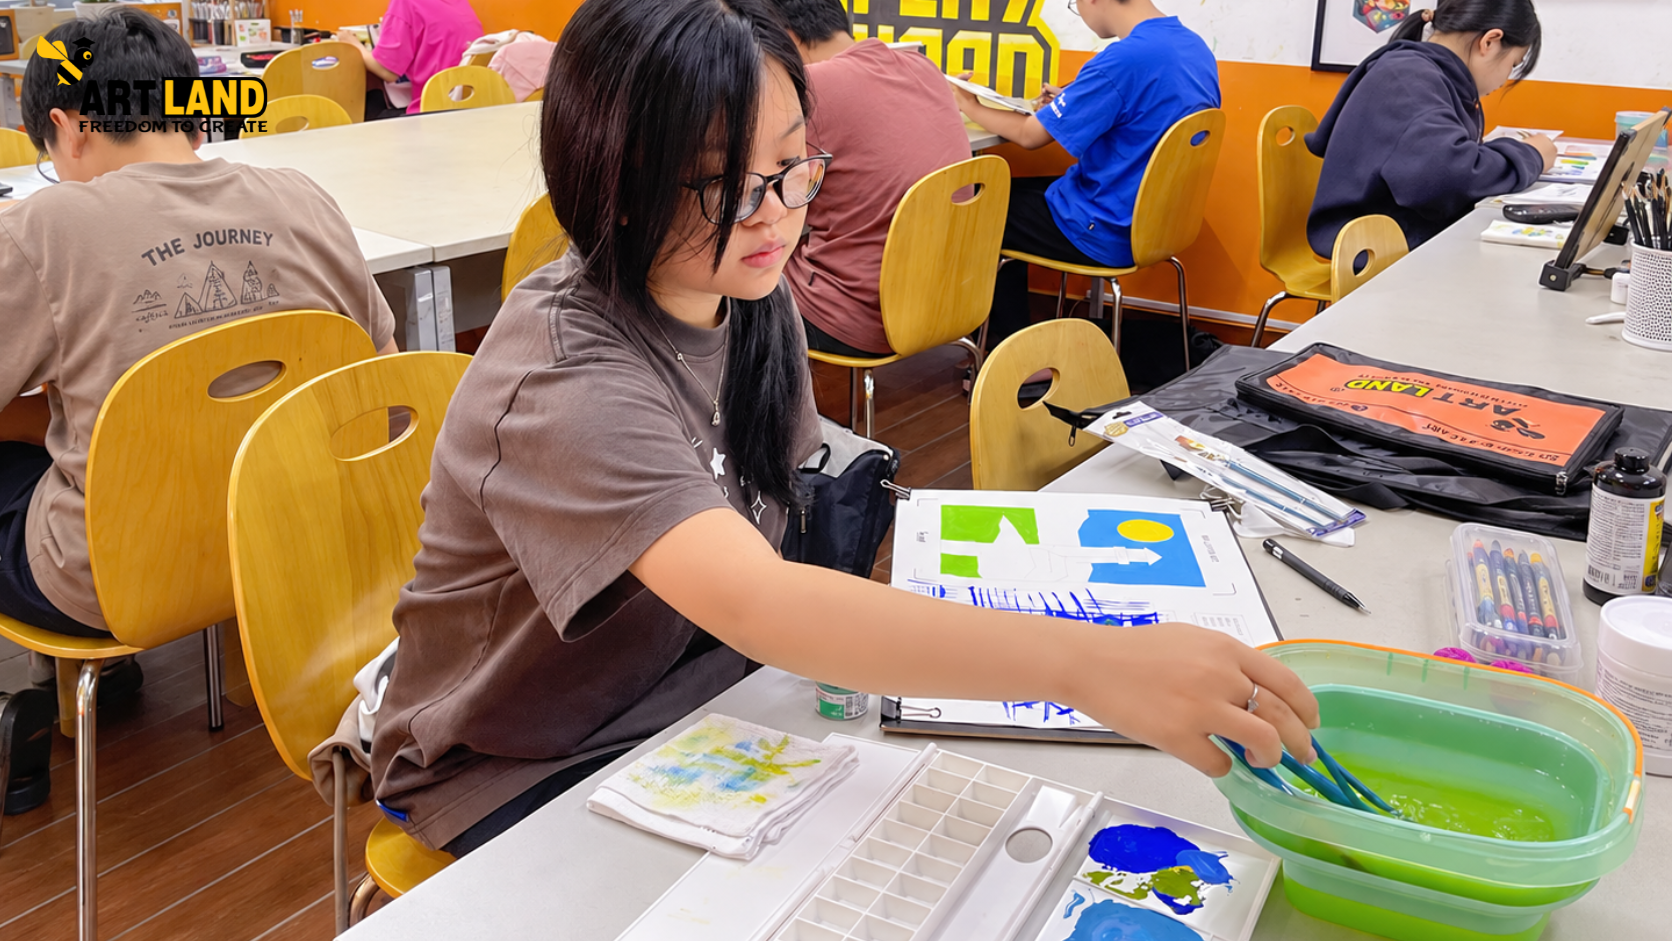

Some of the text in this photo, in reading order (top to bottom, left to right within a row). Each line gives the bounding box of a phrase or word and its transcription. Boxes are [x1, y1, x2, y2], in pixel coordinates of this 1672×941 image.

[141, 228, 273, 266] THE JOURNEY
[1346, 379, 1433, 398] LAND
[1432, 391, 1521, 416] ART
